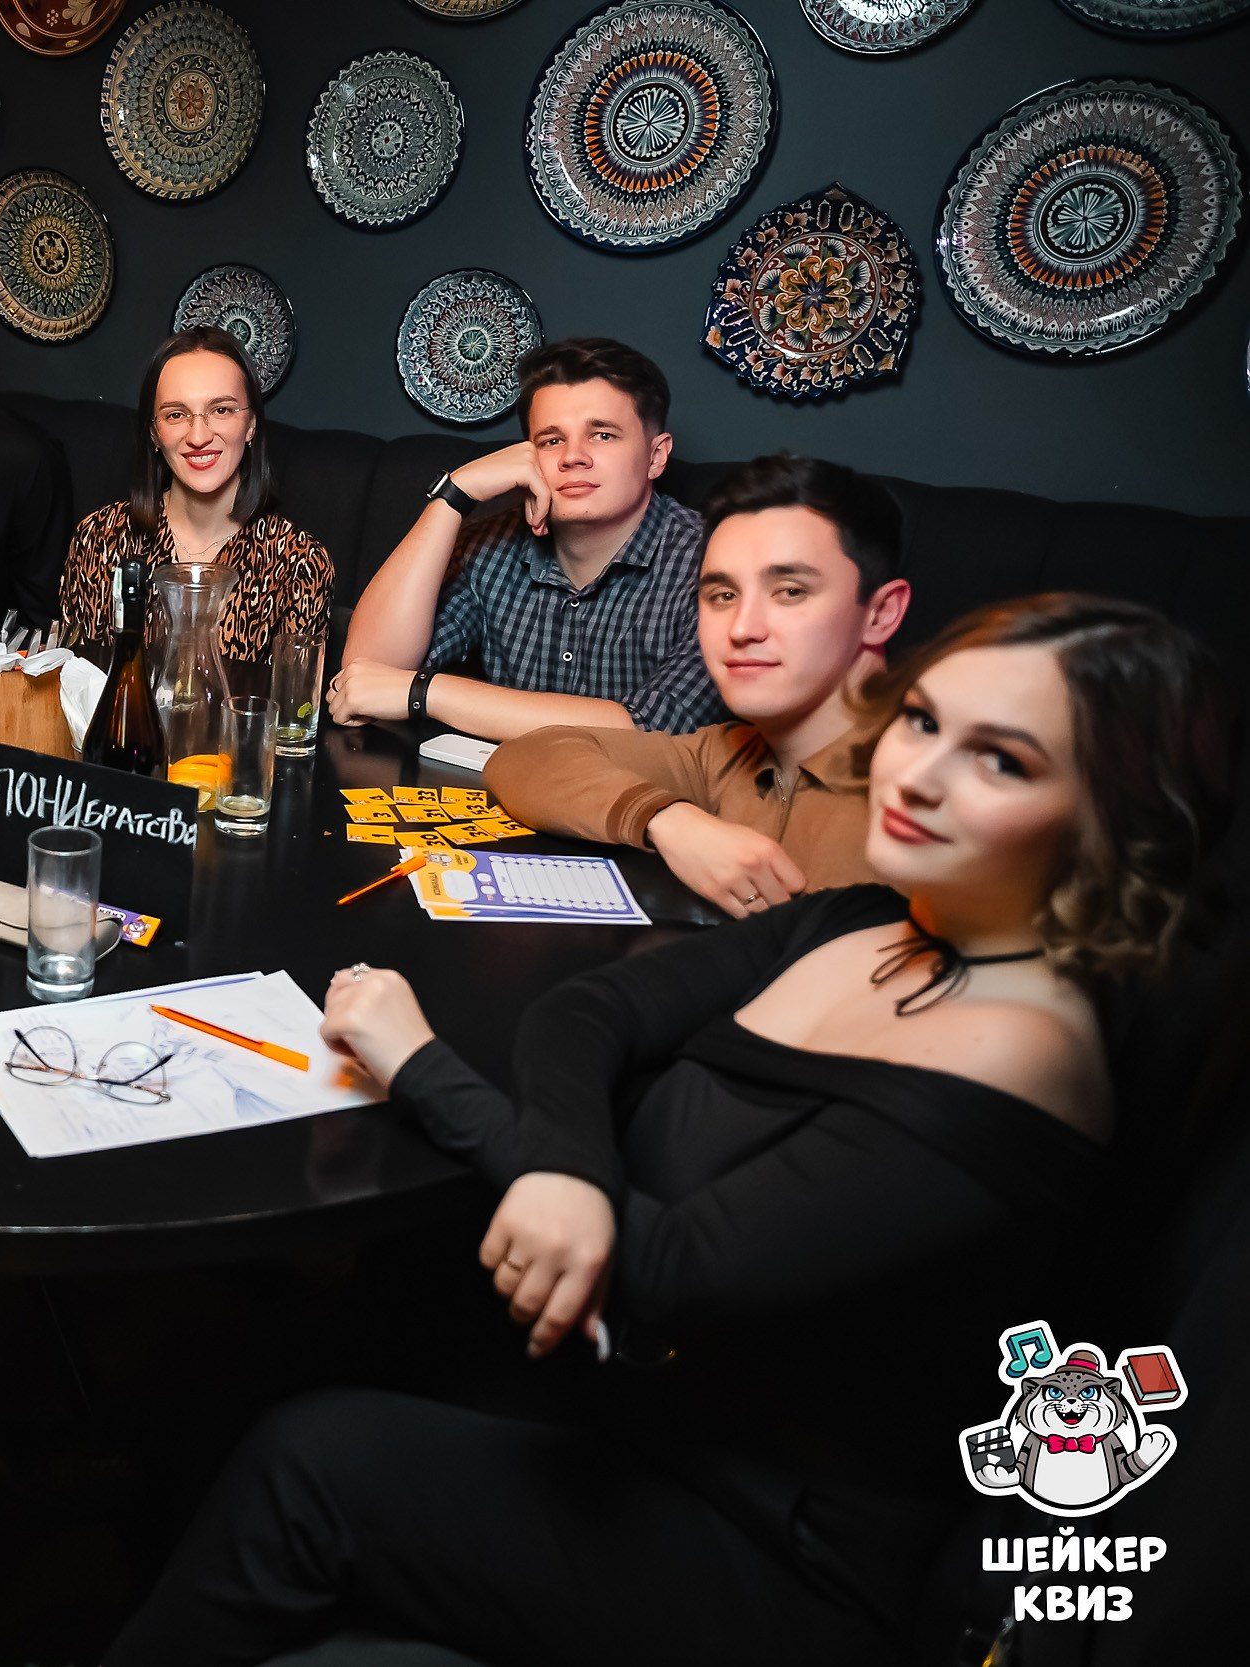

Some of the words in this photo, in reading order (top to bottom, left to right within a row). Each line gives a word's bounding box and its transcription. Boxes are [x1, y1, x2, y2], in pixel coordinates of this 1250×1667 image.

[417, 790, 436, 802] 33
[465, 791, 484, 802] 54
[423, 808, 445, 818] 31
[465, 804, 490, 816] 53
[460, 825, 489, 838] 34
[497, 820, 524, 831] 51
[419, 833, 446, 846] 30
